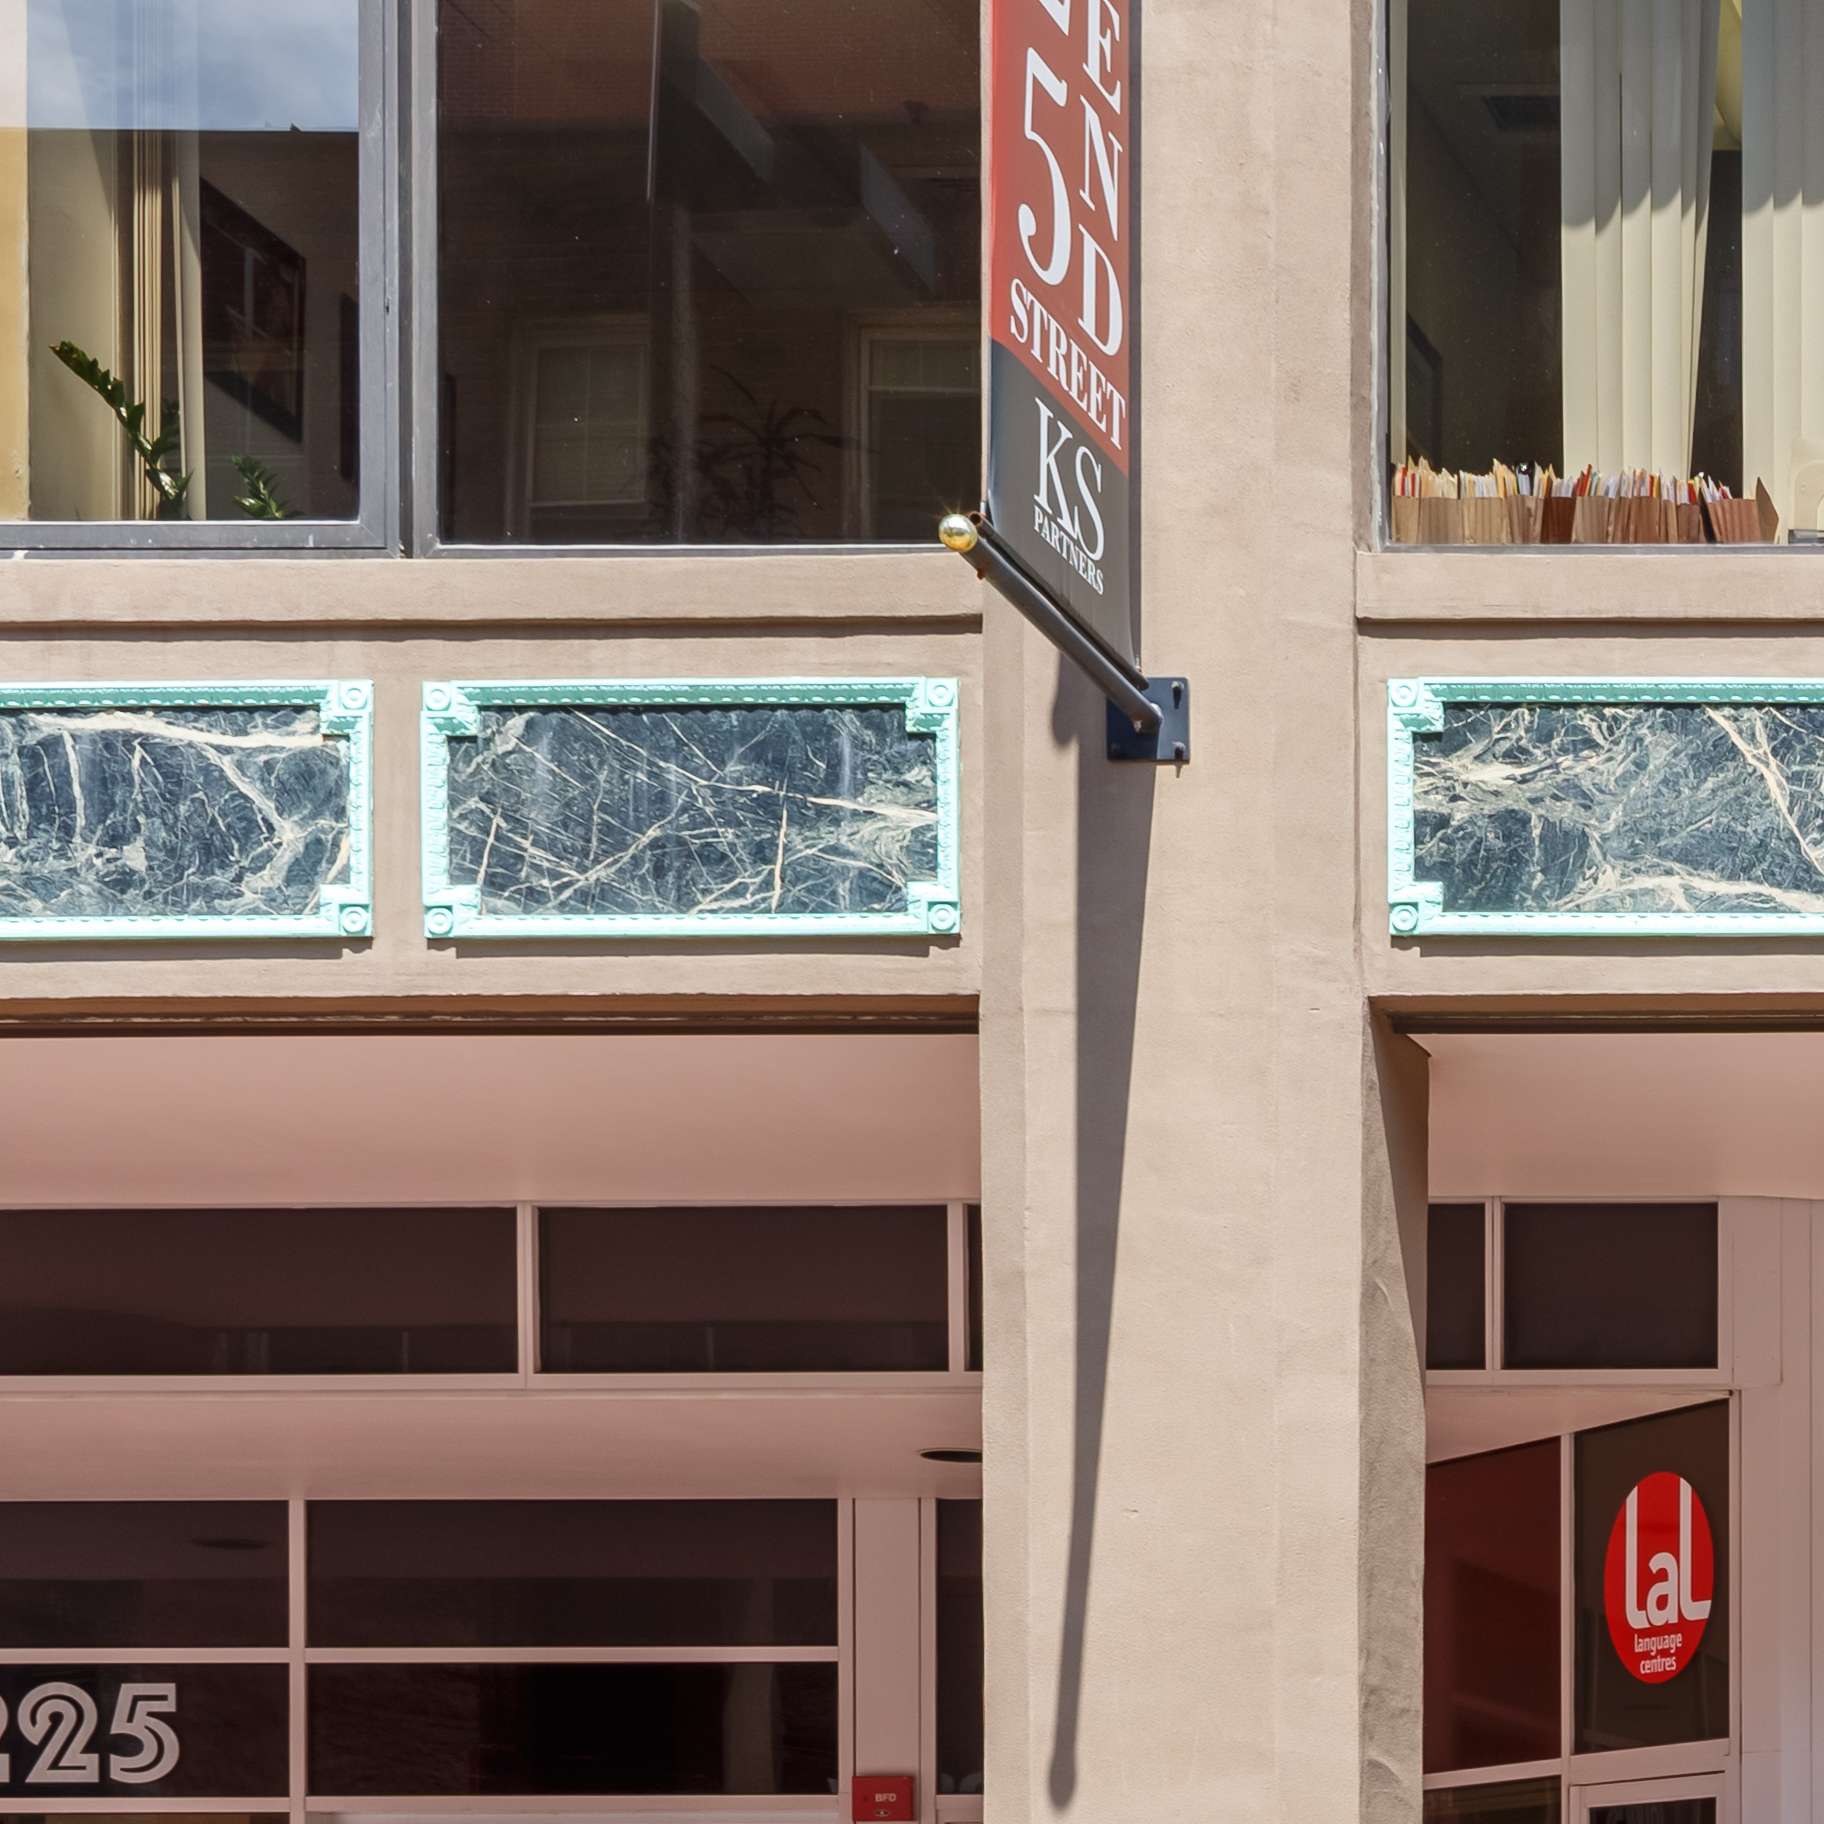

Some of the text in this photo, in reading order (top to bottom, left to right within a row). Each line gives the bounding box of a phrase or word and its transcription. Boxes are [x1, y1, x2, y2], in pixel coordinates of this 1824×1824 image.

[1010, 279, 1126, 450] STREET
[1034, 397, 1104, 564] KS
[1034, 505, 1104, 595] PARTNERS
[1634, 1633, 1683, 1656] language
[1639, 1655, 1677, 1675] centres
[0, 1682, 180, 1784] 25
